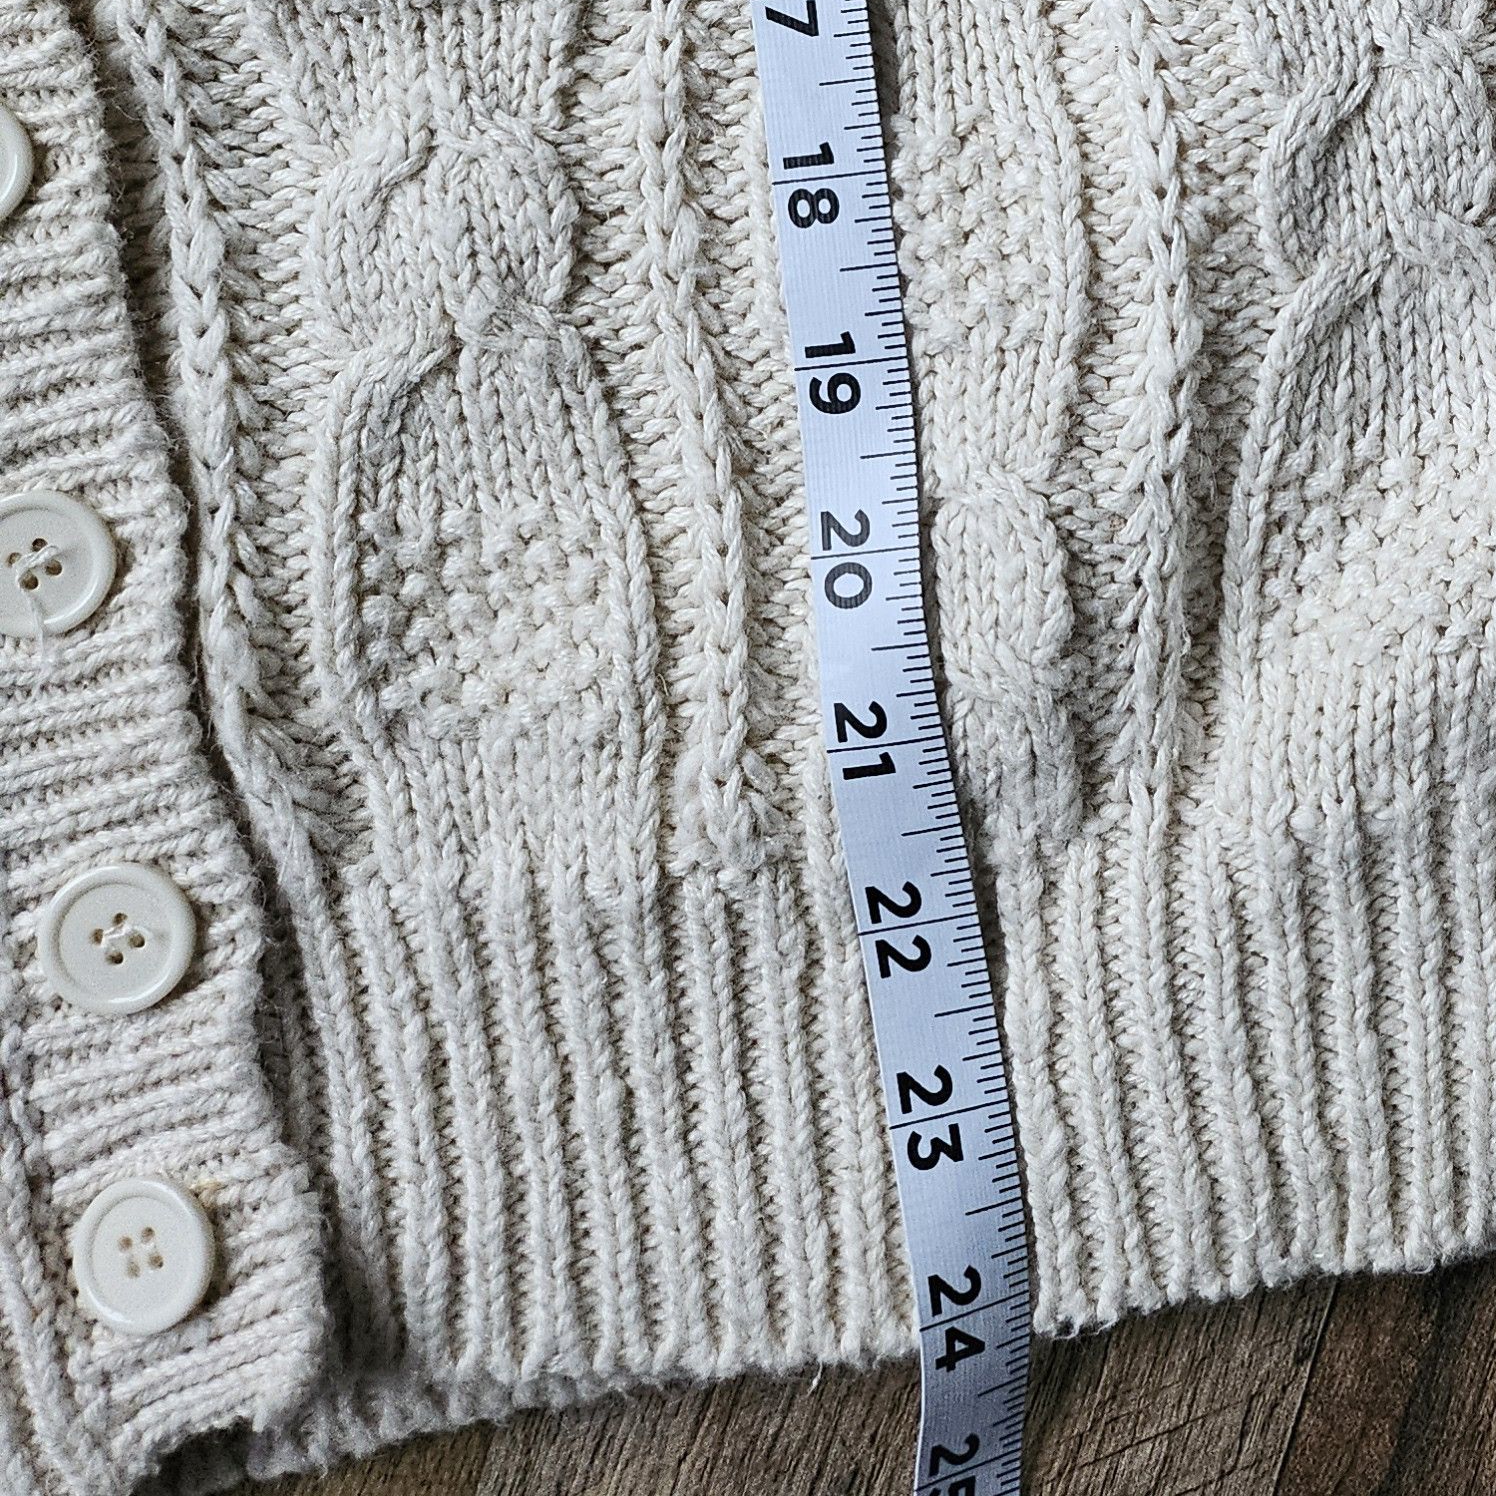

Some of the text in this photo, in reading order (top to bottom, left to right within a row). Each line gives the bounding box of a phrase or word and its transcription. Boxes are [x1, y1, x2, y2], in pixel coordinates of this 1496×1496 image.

[782, 142, 840, 229] 18
[804, 331, 861, 414] 19
[820, 508, 872, 609] 20
[834, 701, 896, 780] 21
[865, 881, 932, 979] 22
[896, 1065, 963, 1171] 23
[928, 1265, 985, 1373] 24
